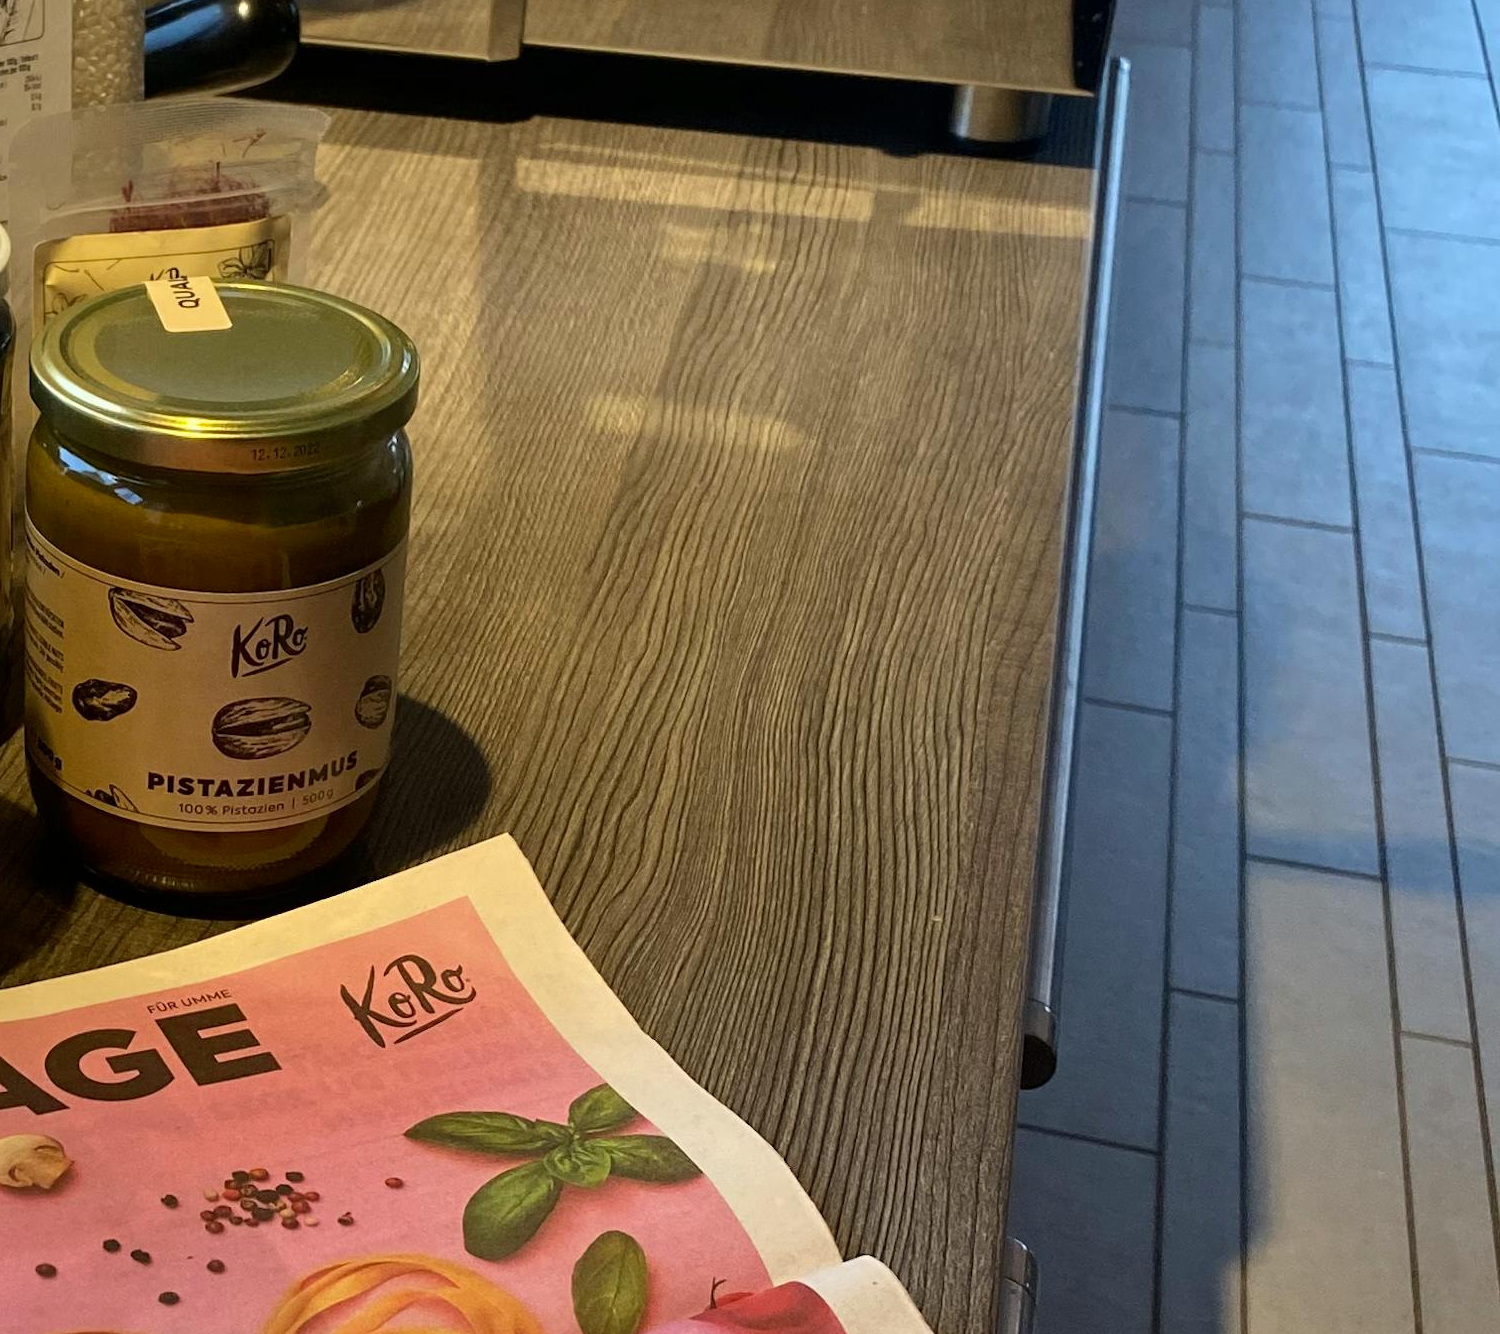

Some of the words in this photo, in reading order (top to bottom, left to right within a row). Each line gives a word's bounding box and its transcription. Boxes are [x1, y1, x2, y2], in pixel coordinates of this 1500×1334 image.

[231, 613, 308, 678] KoRo
[147, 750, 358, 798] PISTAZIENMUS
[222, 801, 285, 816] Pistazien
[146, 1001, 182, 1014] FÜR
[183, 988, 232, 1007] UMME
[339, 954, 477, 1048] KoRo
